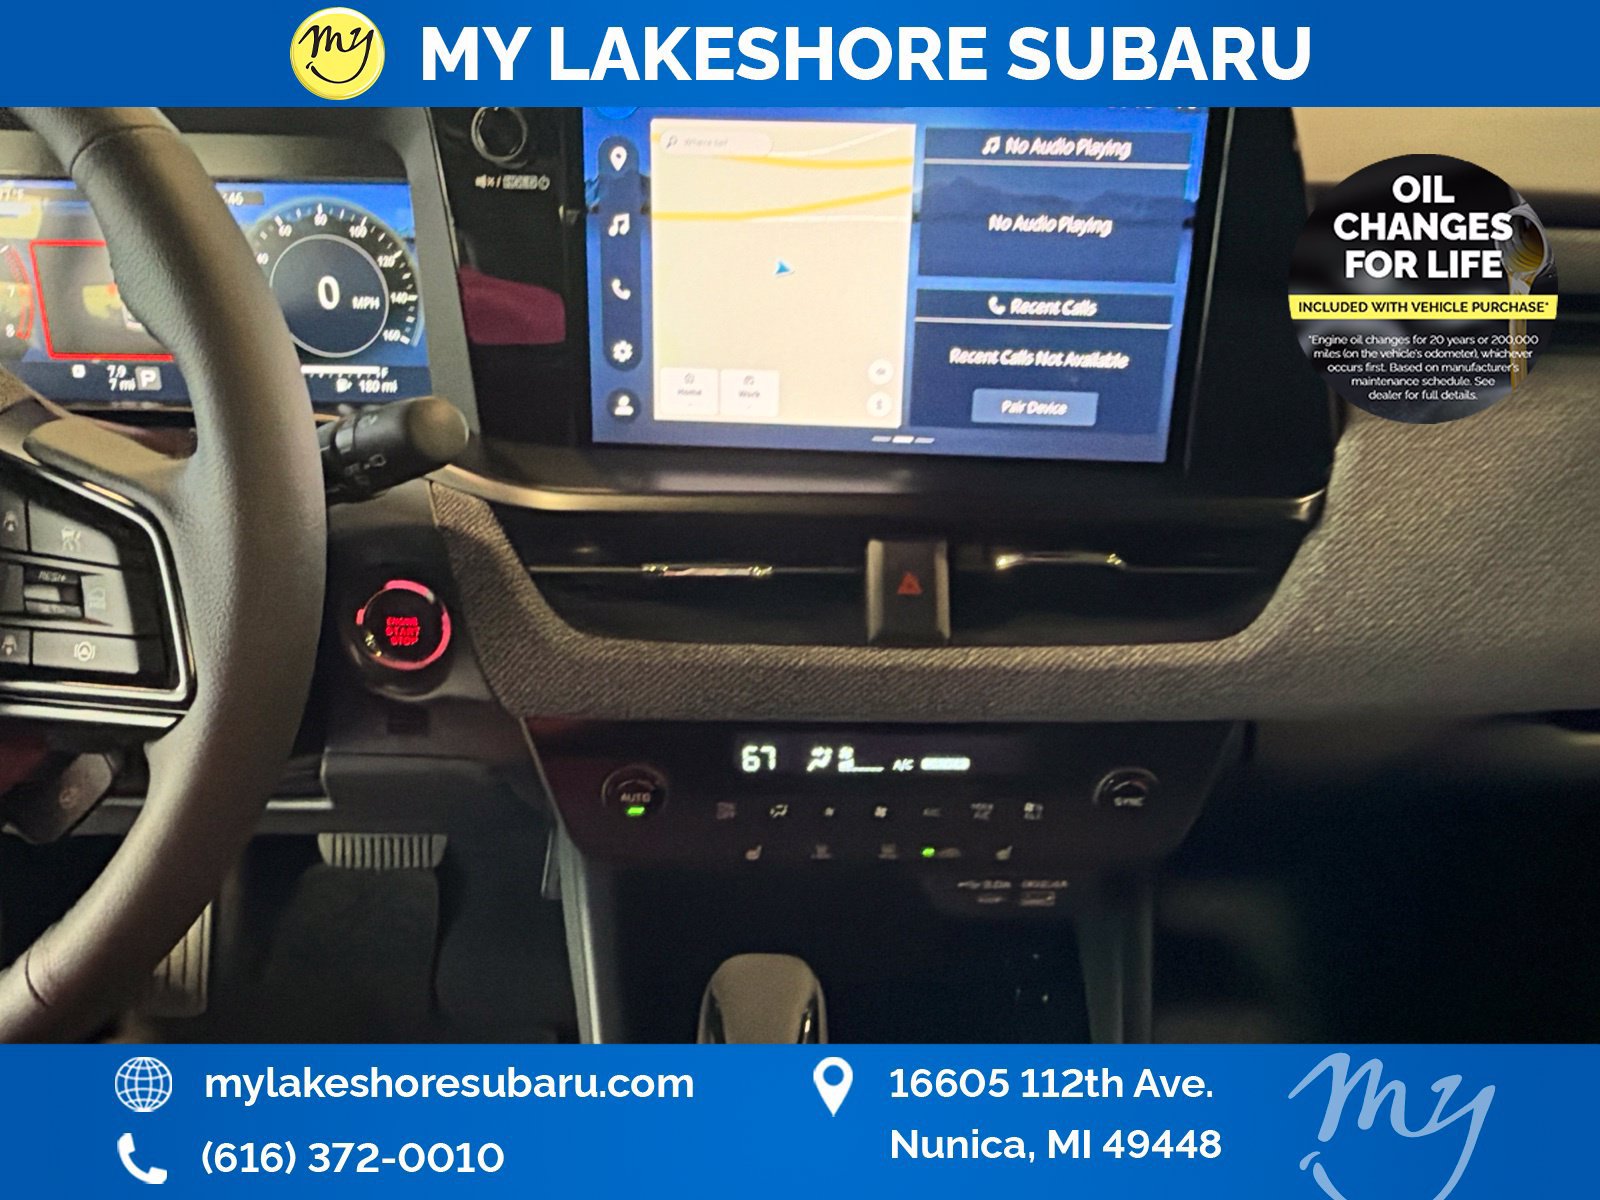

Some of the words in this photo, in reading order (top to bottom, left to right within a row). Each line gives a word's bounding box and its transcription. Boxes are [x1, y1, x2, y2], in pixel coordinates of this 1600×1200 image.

[1005, 136, 1028, 155] No
[1029, 137, 1075, 157] Audio
[1075, 138, 1132, 161] Playing
[988, 214, 1010, 232] No
[1012, 215, 1057, 234] Audio
[1057, 216, 1113, 238] Playing
[318, 275, 340, 310] 0
[352, 296, 380, 310] MPH
[1010, 298, 1060, 316] Recent
[1062, 299, 1098, 317] Calls
[949, 347, 999, 365] Recent
[1000, 349, 1035, 367] Calls
[1035, 350, 1063, 368] Not
[1063, 351, 1130, 370] Available
[140, 370, 157, 388] P
[1001, 399, 1027, 414] Pair
[1027, 400, 1067, 415] Device
[741, 745, 776, 772] 67
